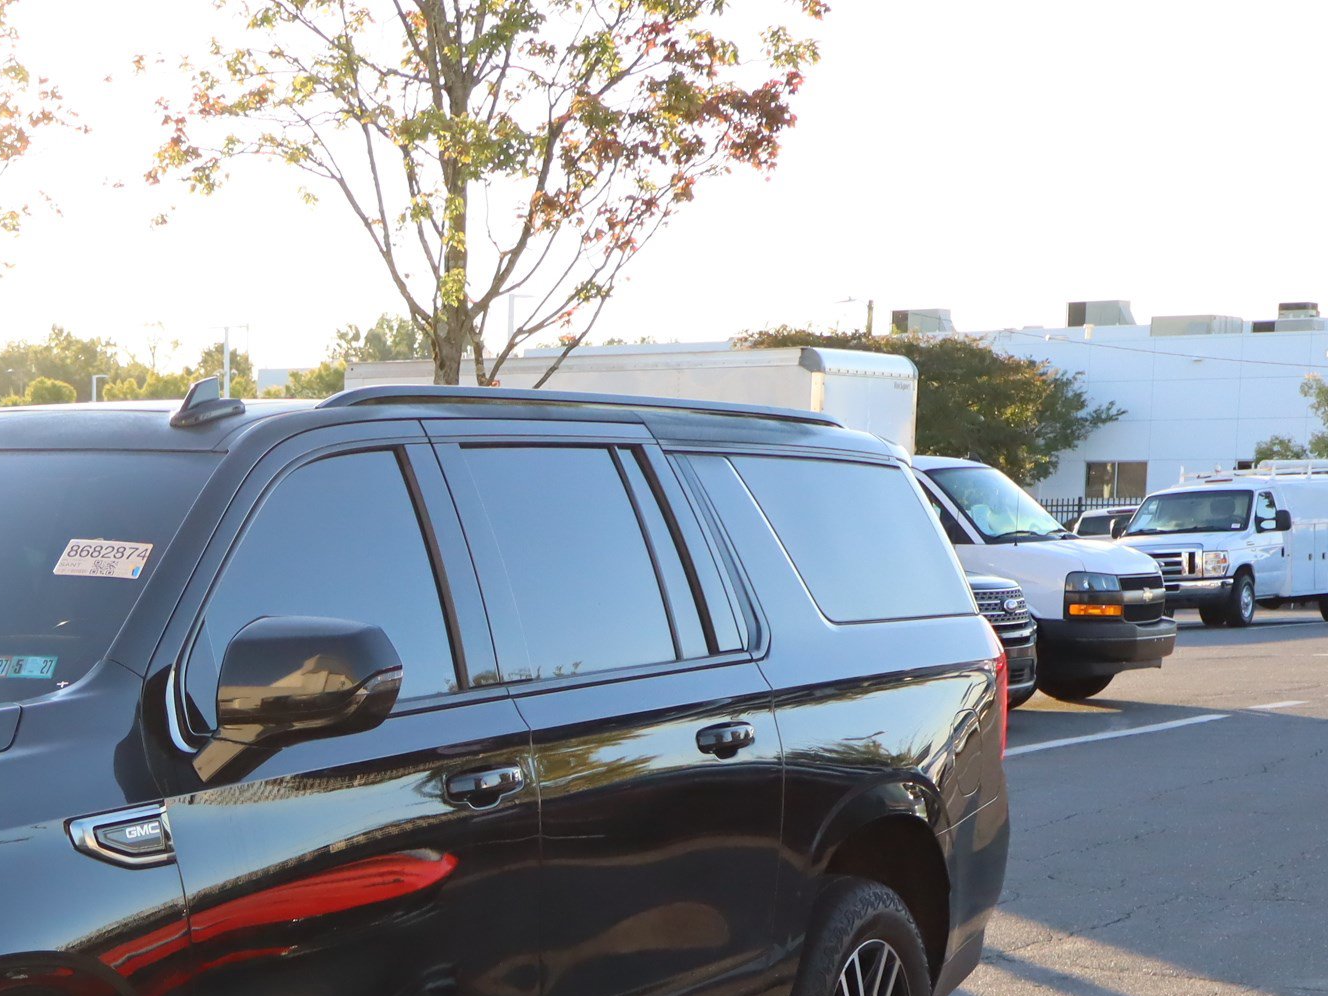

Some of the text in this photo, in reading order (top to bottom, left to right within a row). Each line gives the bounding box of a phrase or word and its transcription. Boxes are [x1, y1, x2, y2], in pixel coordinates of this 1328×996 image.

[67, 544, 149, 561] 8682874
[13, 659, 54, 675] 5 27
[125, 821, 161, 839] GMC
